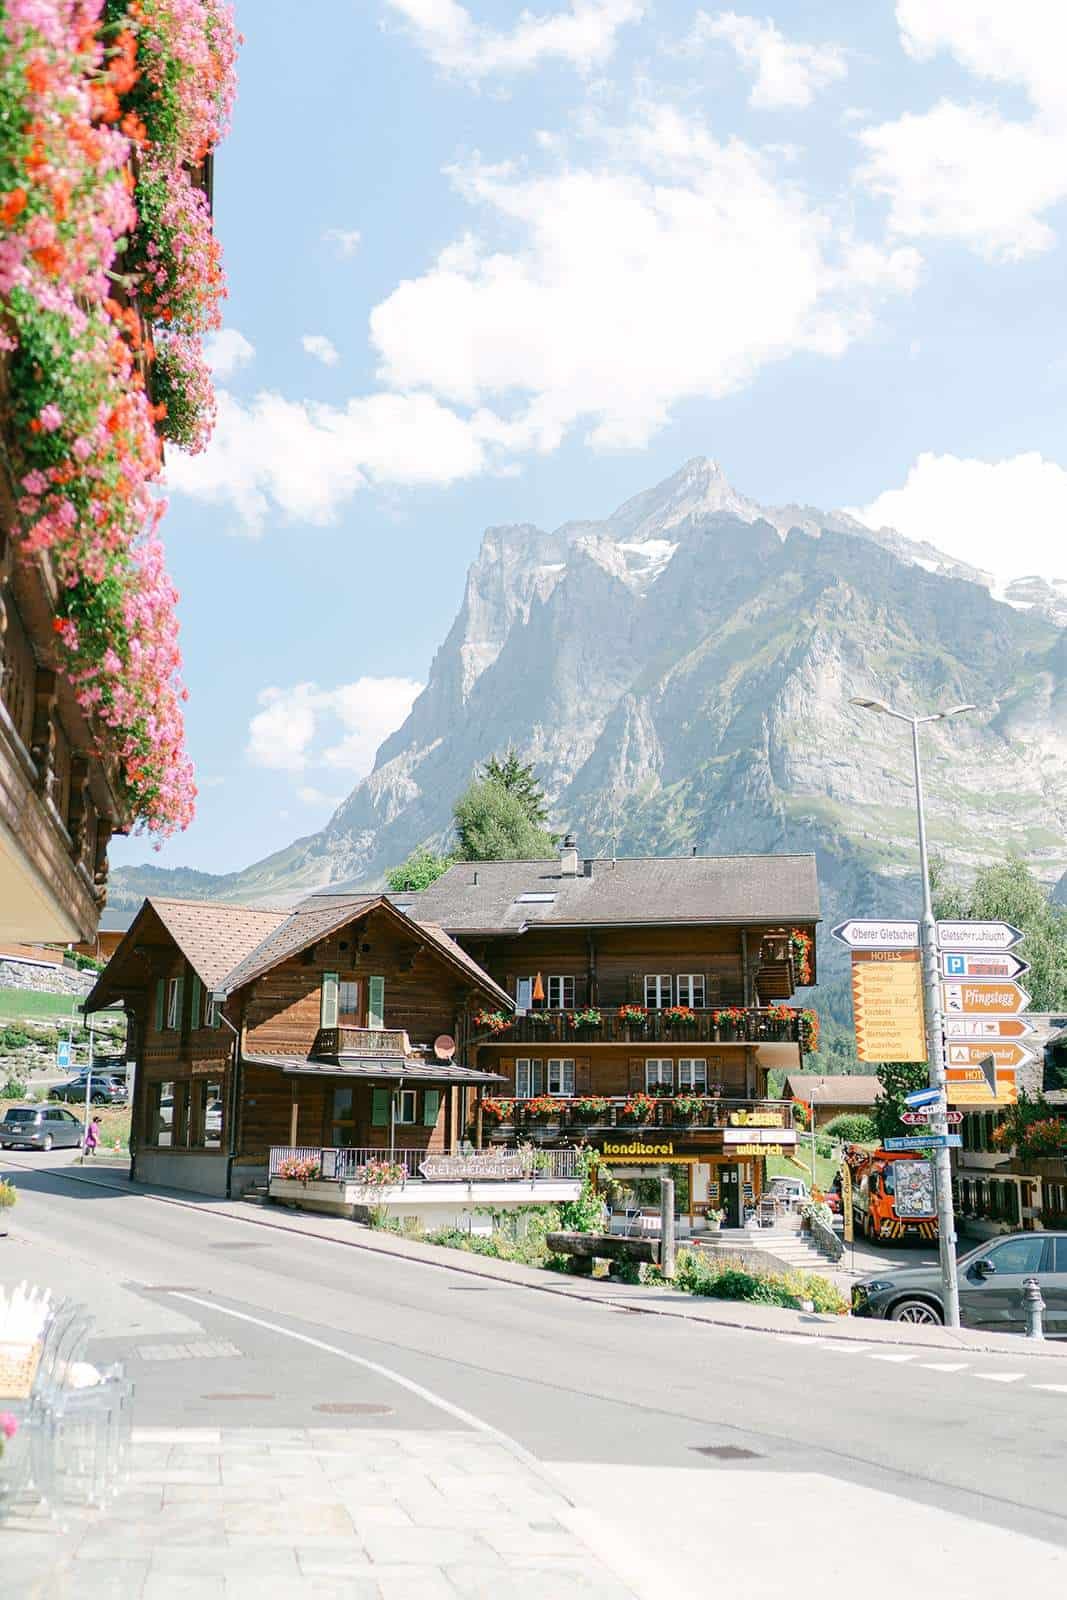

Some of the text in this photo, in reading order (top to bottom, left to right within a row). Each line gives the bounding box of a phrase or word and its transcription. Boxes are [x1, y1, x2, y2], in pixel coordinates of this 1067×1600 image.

[852, 927, 916, 940] Oberer Gletscher
[871, 951, 902, 960] HOTELS
[965, 990, 1015, 1007] Pfingstegg
[603, 1141, 673, 1154] konditorei
